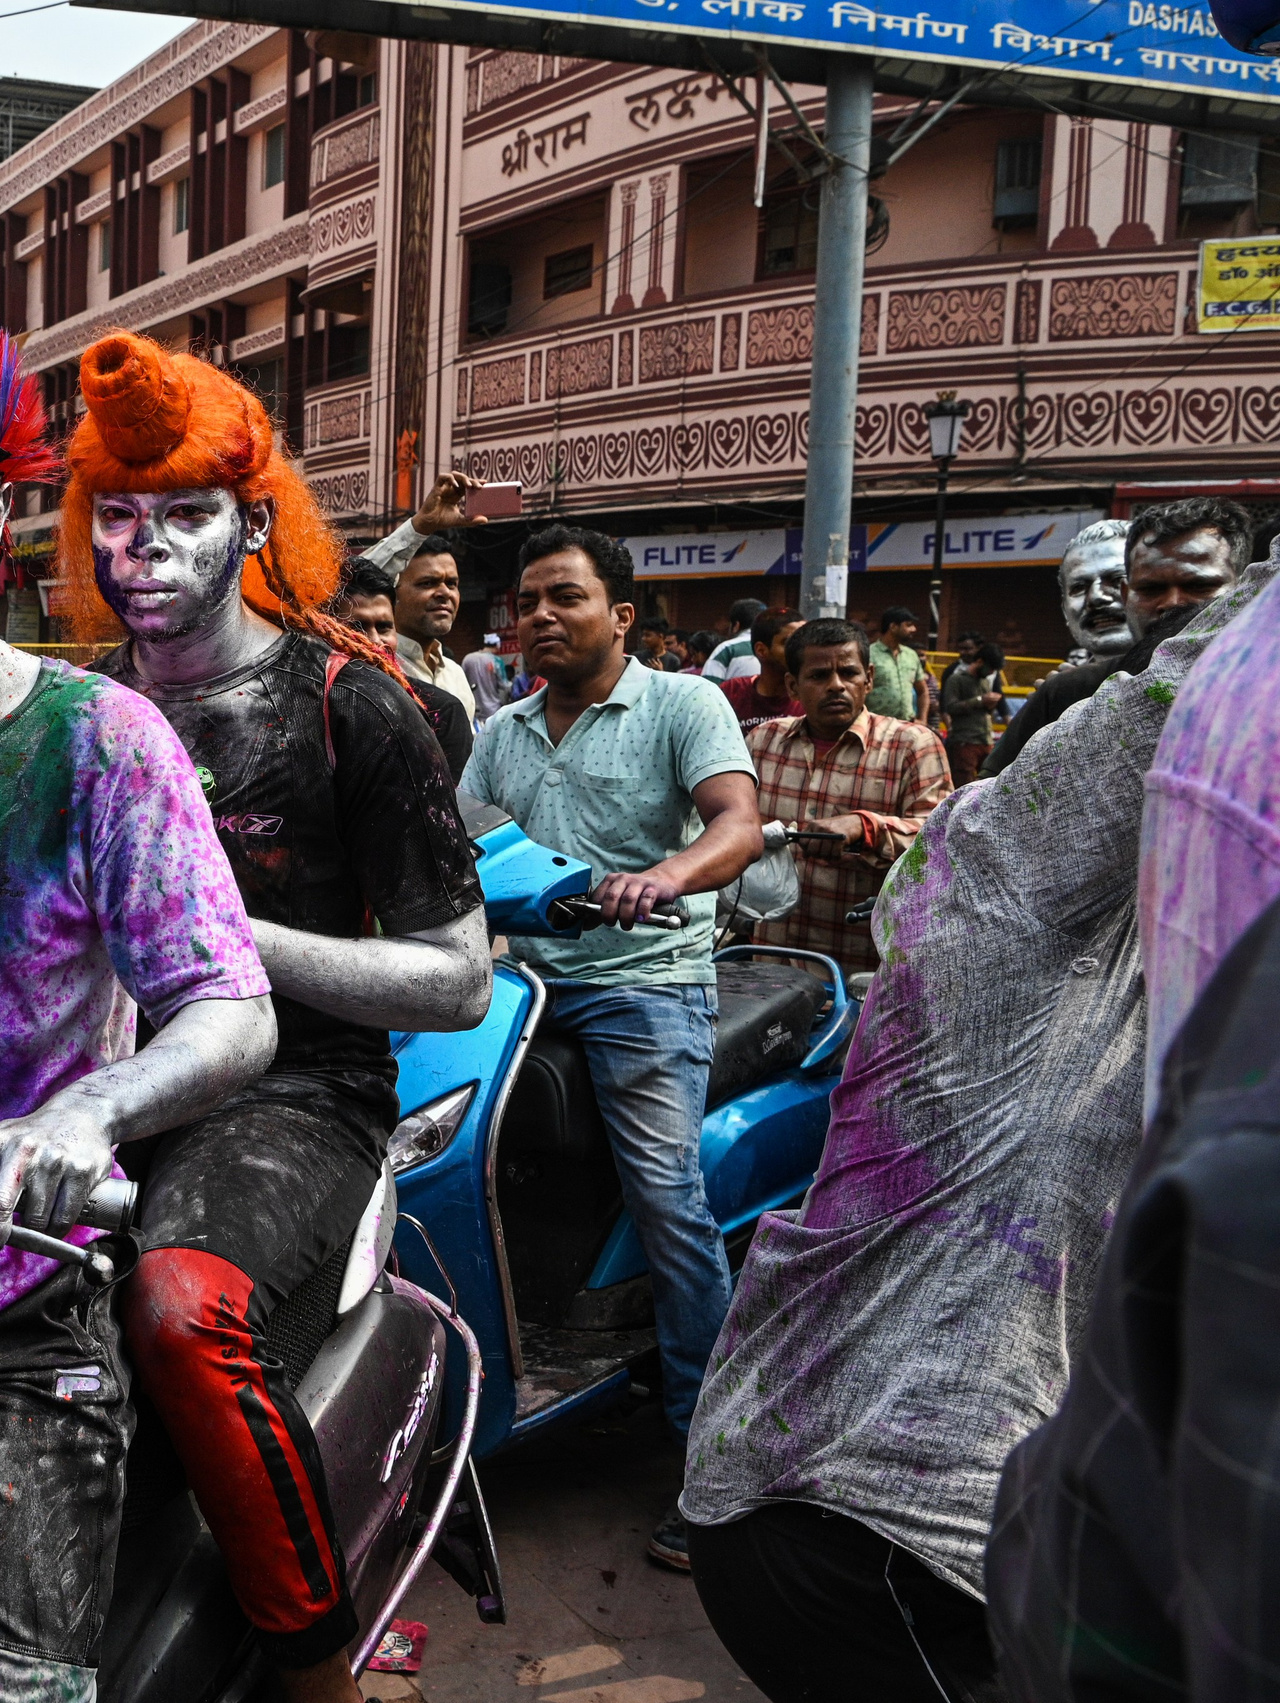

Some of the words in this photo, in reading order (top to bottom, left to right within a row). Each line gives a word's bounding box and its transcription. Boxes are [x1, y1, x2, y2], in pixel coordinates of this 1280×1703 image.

[1128, 1, 1222, 39] DASHAS
[828, 2, 968, 44] निर्माण
[1138, 45, 1280, 83] वाराणस
[644, 544, 716, 567] FLITE
[923, 529, 1015, 554] FLITE
